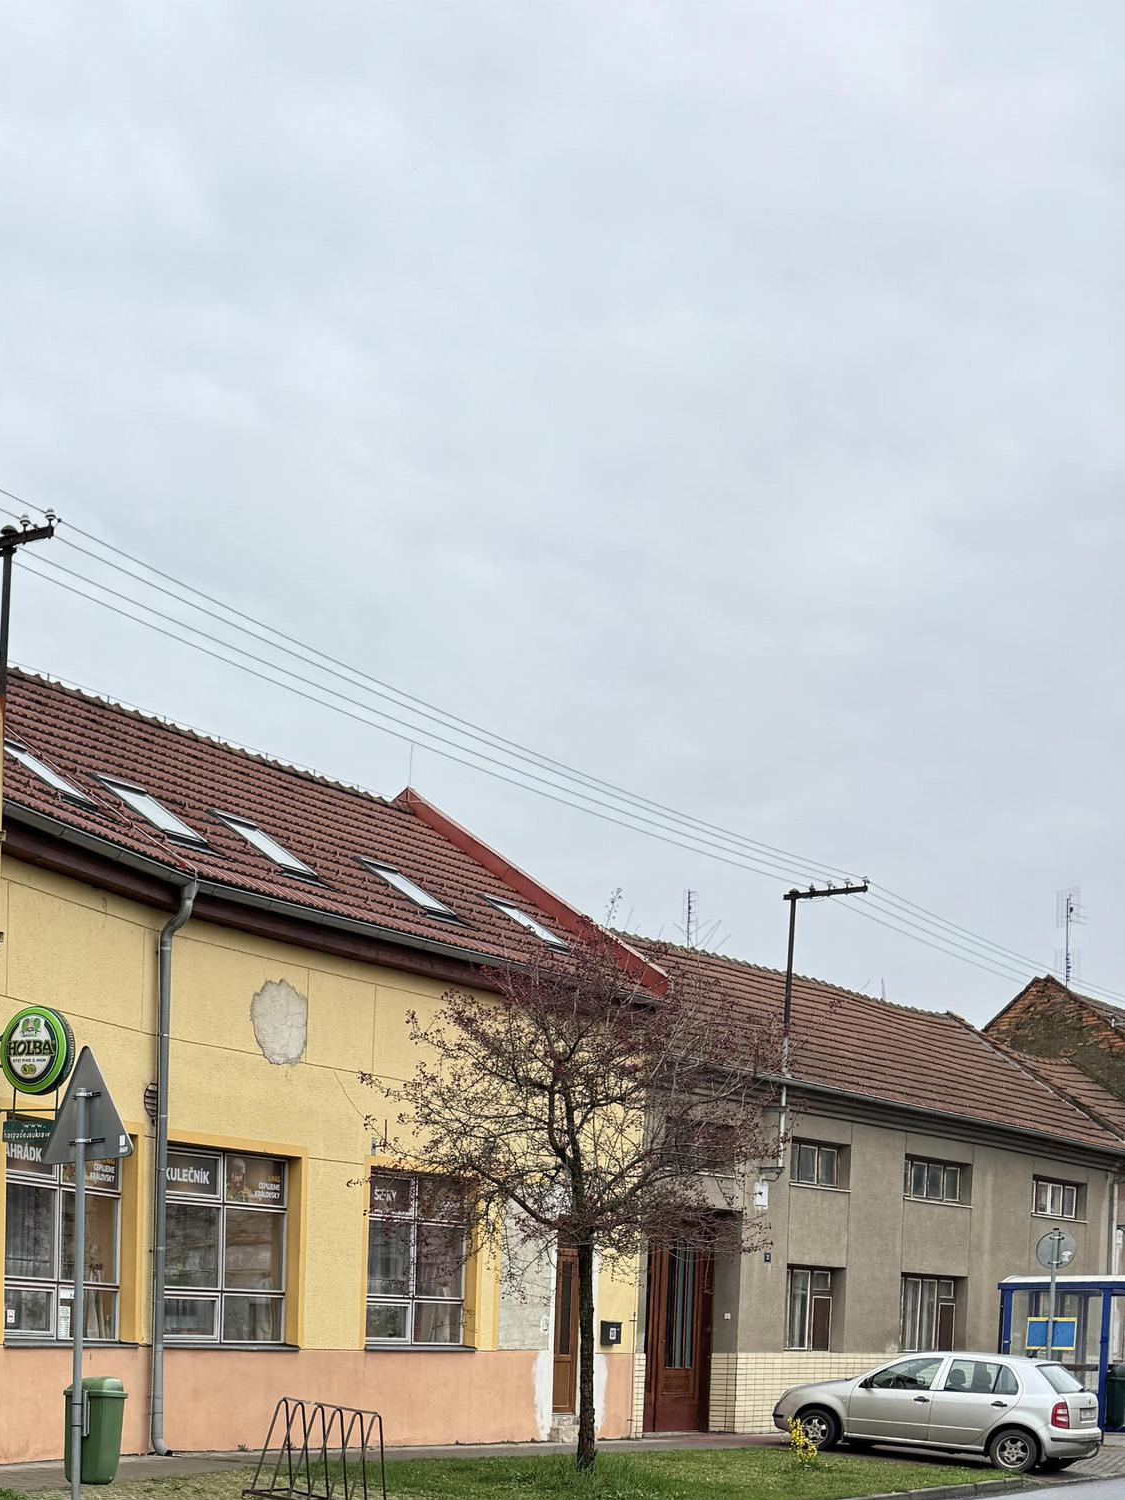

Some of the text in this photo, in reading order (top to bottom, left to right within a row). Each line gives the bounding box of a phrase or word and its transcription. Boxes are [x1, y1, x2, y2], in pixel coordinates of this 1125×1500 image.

[7, 1040, 55, 1056] HOLBA
[6, 1143, 42, 1163] AHRÁDK
[166, 1166, 210, 1184] KULEČNÍK
